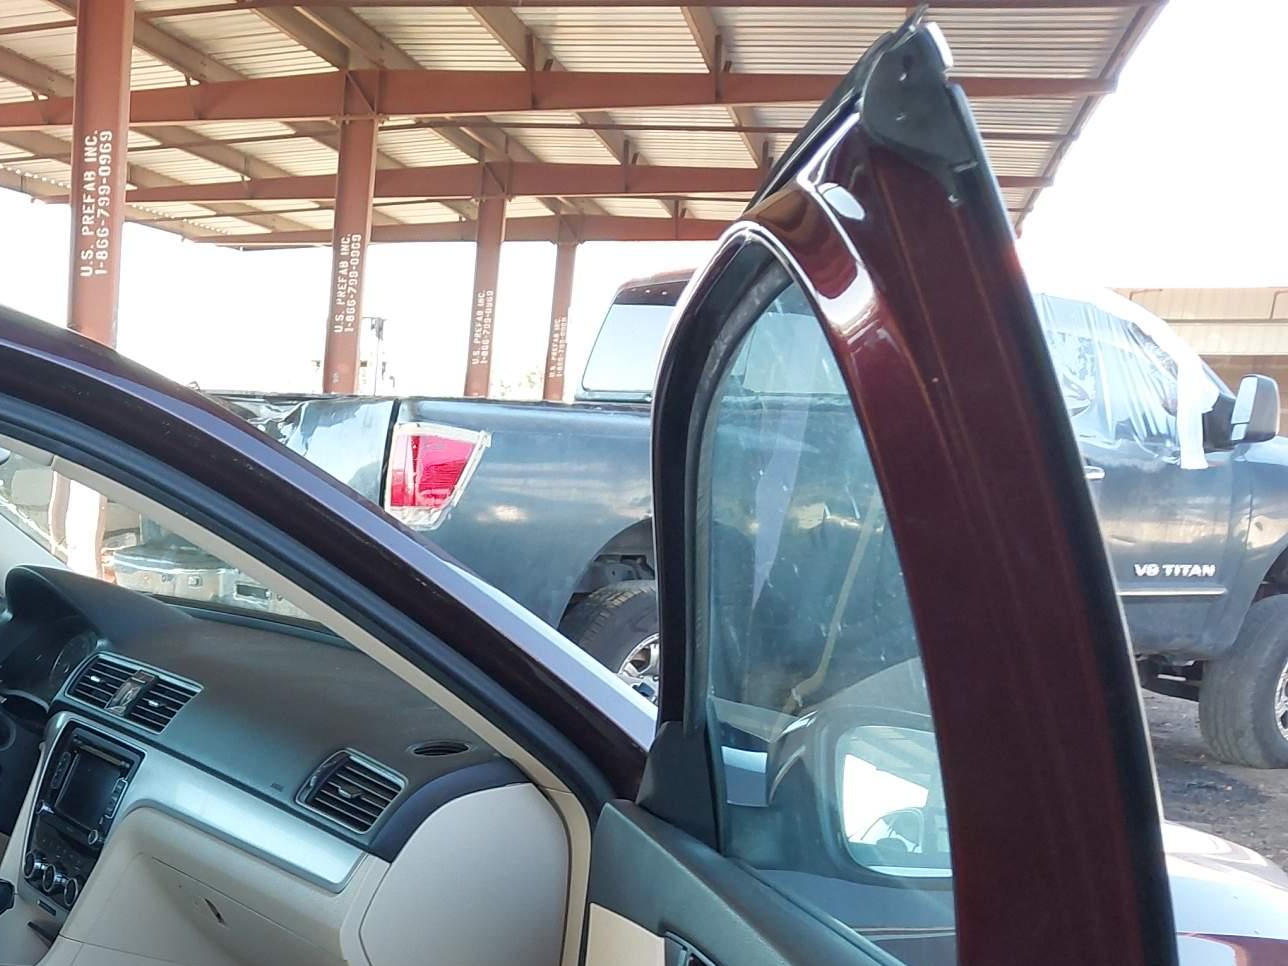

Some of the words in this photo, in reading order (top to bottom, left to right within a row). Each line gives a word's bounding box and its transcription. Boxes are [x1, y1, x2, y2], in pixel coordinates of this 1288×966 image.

[84, 129, 98, 163] INC.
[81, 170, 97, 236] PREFAB
[95, 130, 113, 276] 1-866-799-0969
[340, 233, 351, 256] INC.
[80, 246, 95, 277] U.S.
[336, 260, 349, 306] PREFAB
[333, 310, 345, 333] U.S.
[1161, 563, 1216, 577] TITAN
